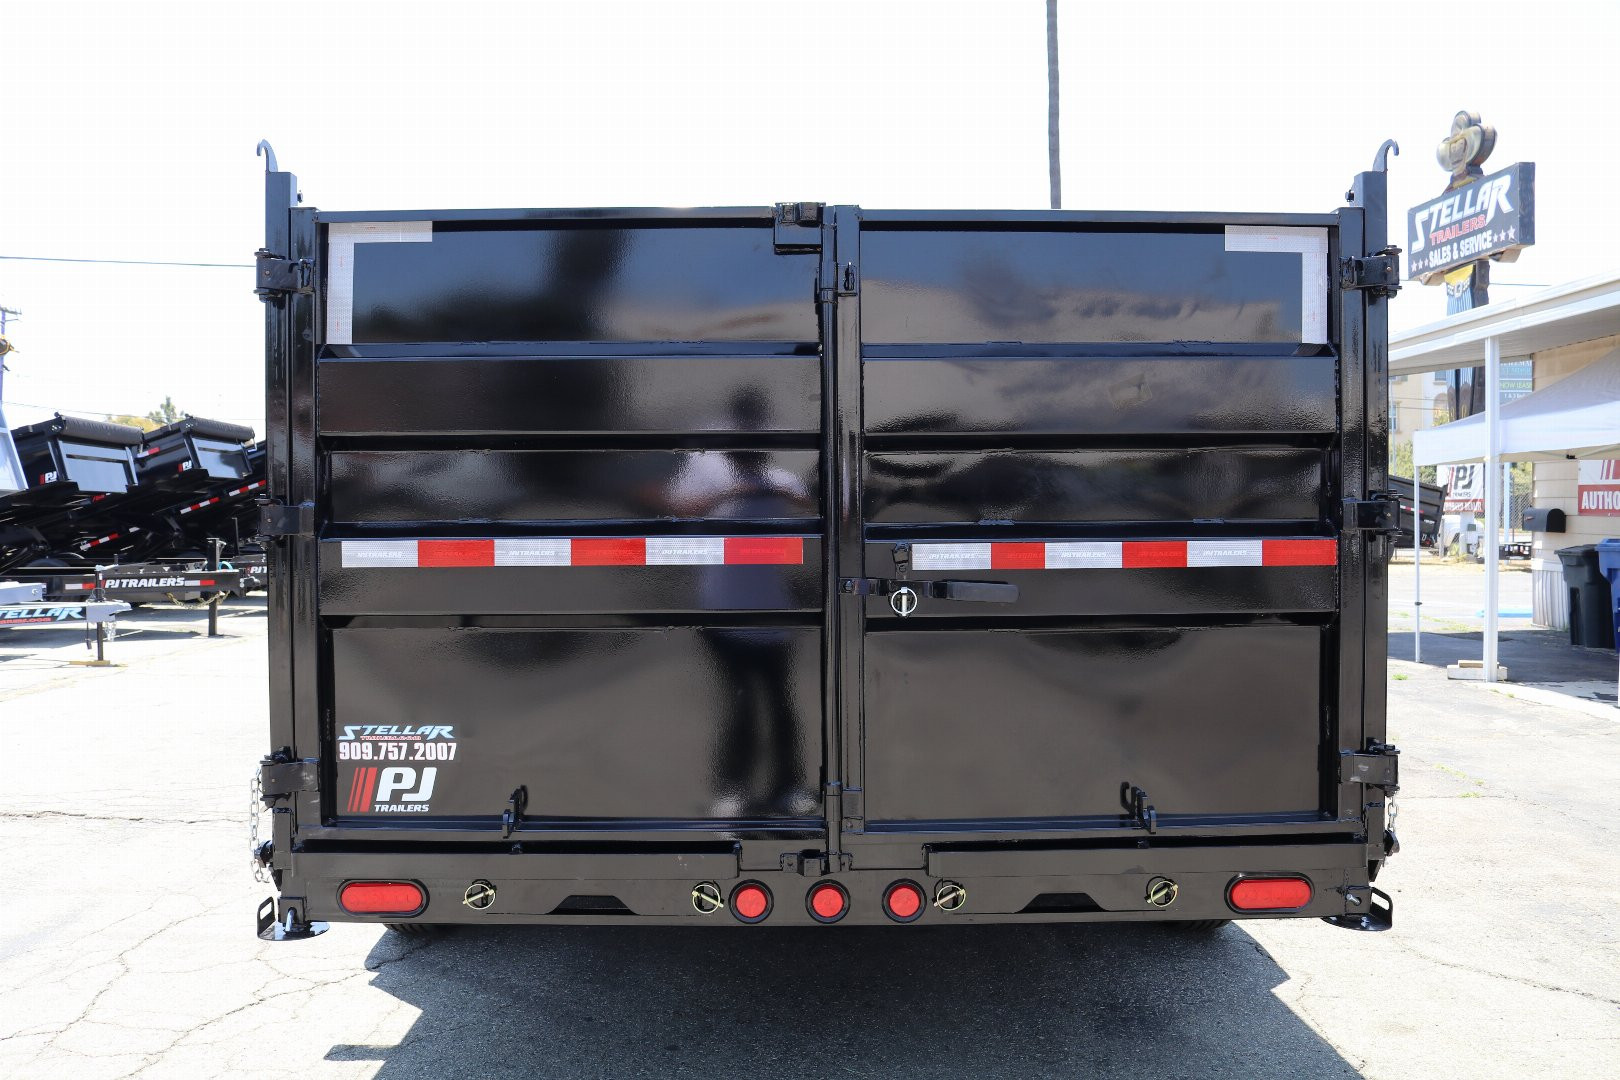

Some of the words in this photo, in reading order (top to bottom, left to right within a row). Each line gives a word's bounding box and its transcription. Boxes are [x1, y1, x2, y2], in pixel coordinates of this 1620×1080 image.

[1411, 175, 1514, 254] STELLAR
[1430, 214, 1486, 246] TRAILERS
[1429, 245, 1451, 268] SALES
[1453, 242, 1459, 260] &
[1460, 229, 1493, 258] SERVICE
[1454, 465, 1475, 490] PJ
[1581, 491, 1620, 510] AUTHO
[338, 725, 455, 740] STELLAR
[339, 742, 457, 760] 909.757.2007
[376, 766, 437, 801] PJ
[374, 804, 430, 812] TRAILERS
